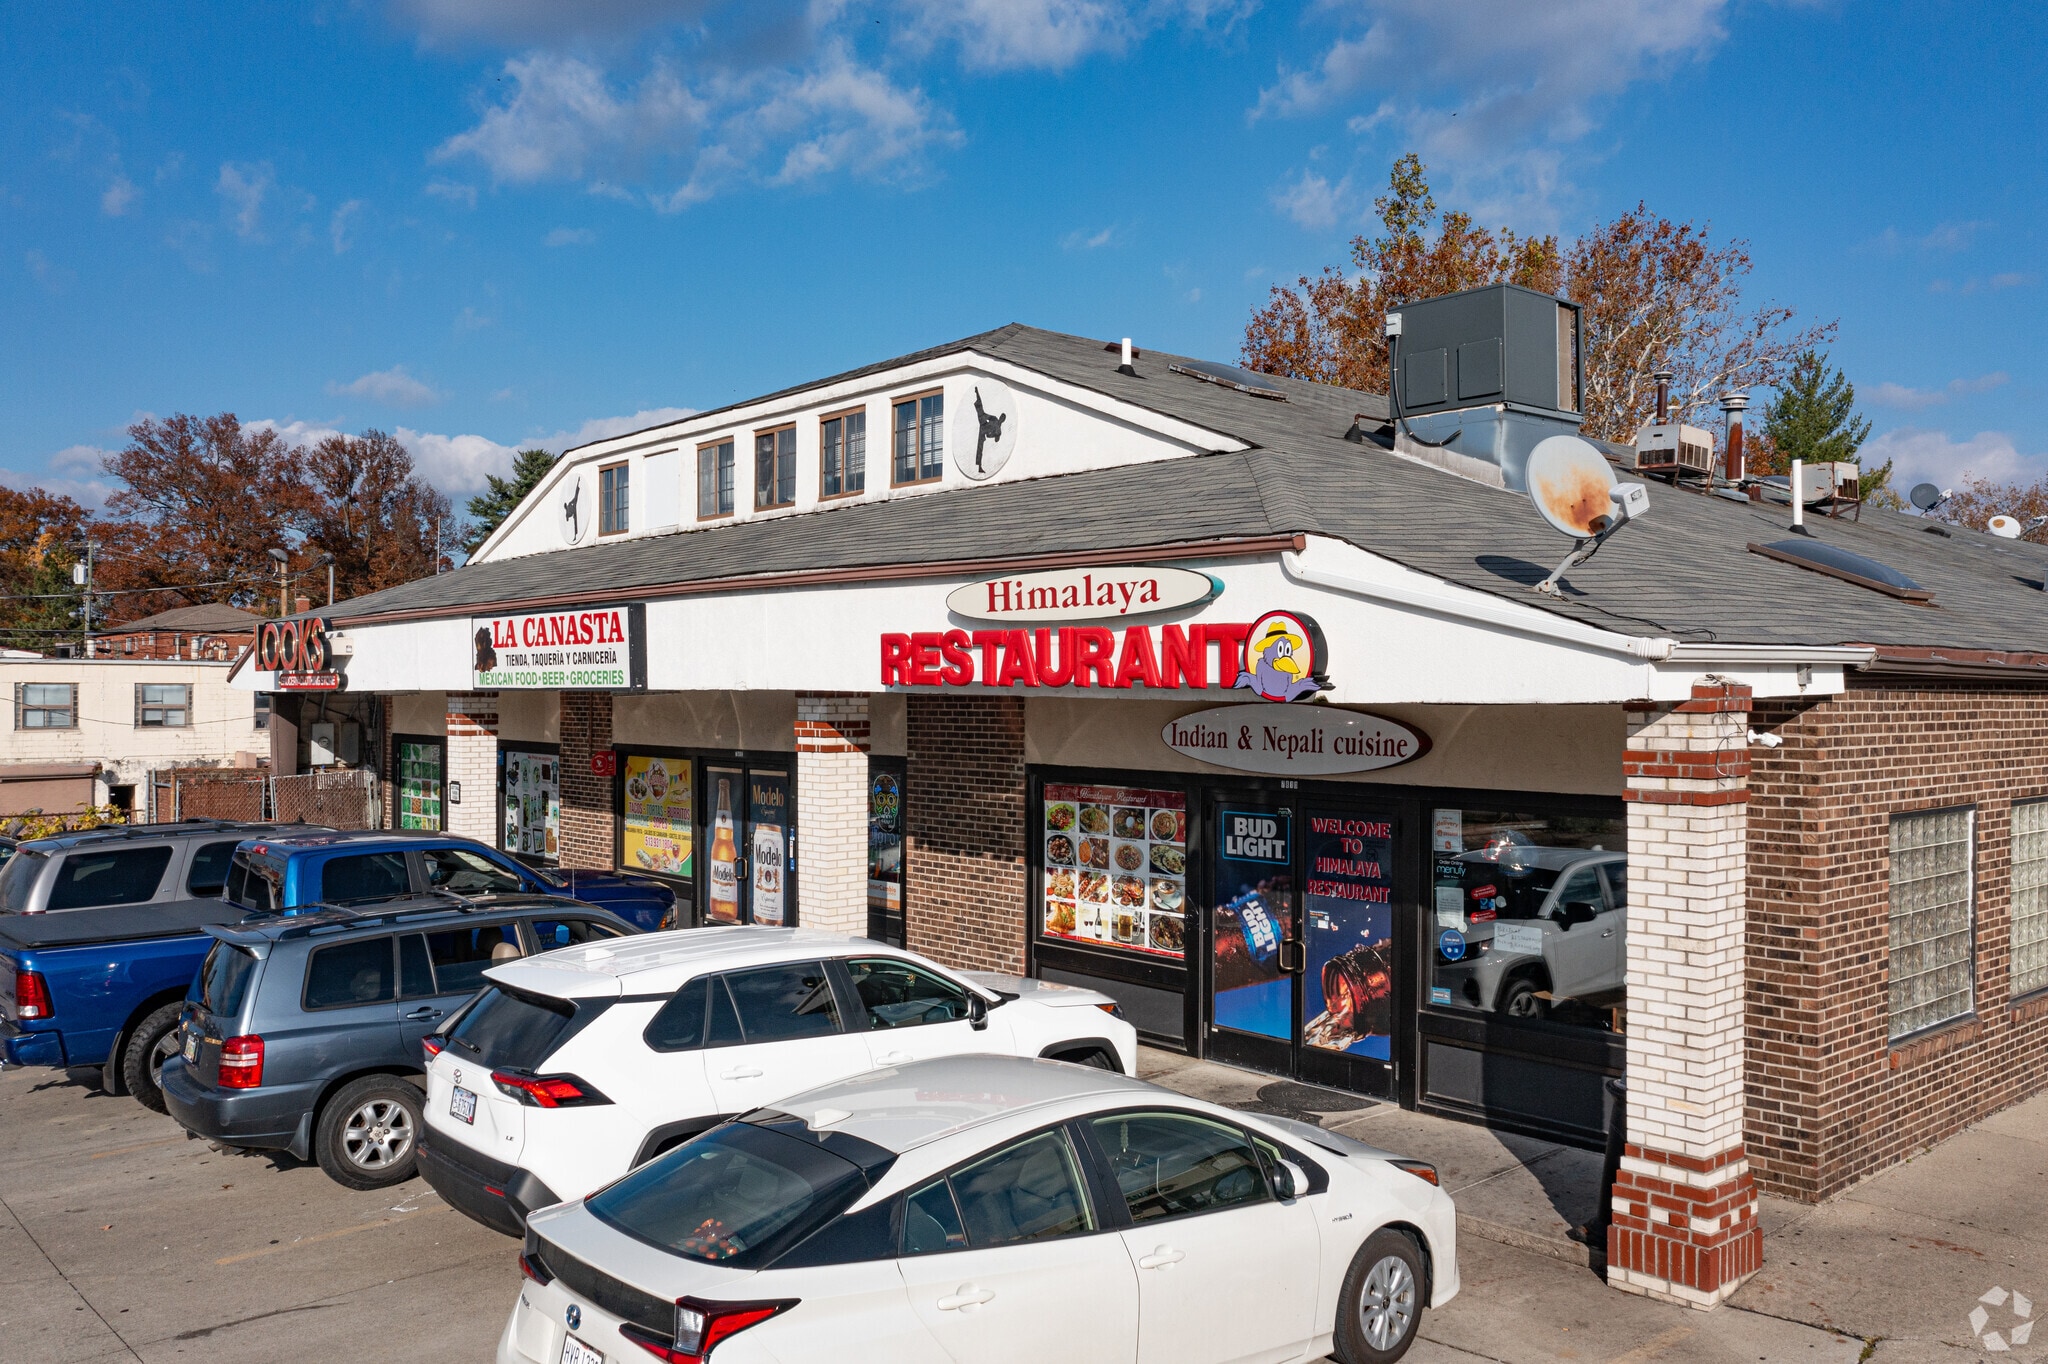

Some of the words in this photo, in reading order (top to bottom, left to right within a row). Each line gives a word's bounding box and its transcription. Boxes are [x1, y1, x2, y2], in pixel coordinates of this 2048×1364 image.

[985, 574, 1161, 614] Himalaya
[492, 619, 518, 649] LA
[523, 611, 625, 647] CANASTA
[254, 617, 324, 671] LOOKS
[505, 654, 530, 668] TIENDA,
[566, 652, 571, 665] Y
[880, 622, 1254, 690] RESTAURANT
[479, 672, 513, 685] MEXICAN
[515, 671, 538, 686] FOOD
[542, 671, 565, 685] BEER
[570, 669, 624, 685] GROCERIES
[1171, 722, 1228, 749] Indian
[1237, 725, 1253, 750] &
[1263, 725, 1323, 760] Nepali
[1333, 730, 1408, 758] cuisine
[752, 784, 784, 807] Modelo
[629, 801, 642, 814] TACOS
[646, 803, 663, 817] TORTAS
[667, 806, 690, 820] BURRITOS
[1234, 817, 1277, 838] BUD
[1311, 817, 1391, 839] WELCOME
[755, 844, 782, 867] Modelo
[1340, 837, 1363, 855] TO
[1316, 857, 1382, 879] HIMALAYA
[1436, 865, 1467, 877] menufy
[1307, 879, 1391, 904] RESTAURANT
[1242, 909, 1266, 948] BUD
[1247, 900, 1277, 952] LIGHT
